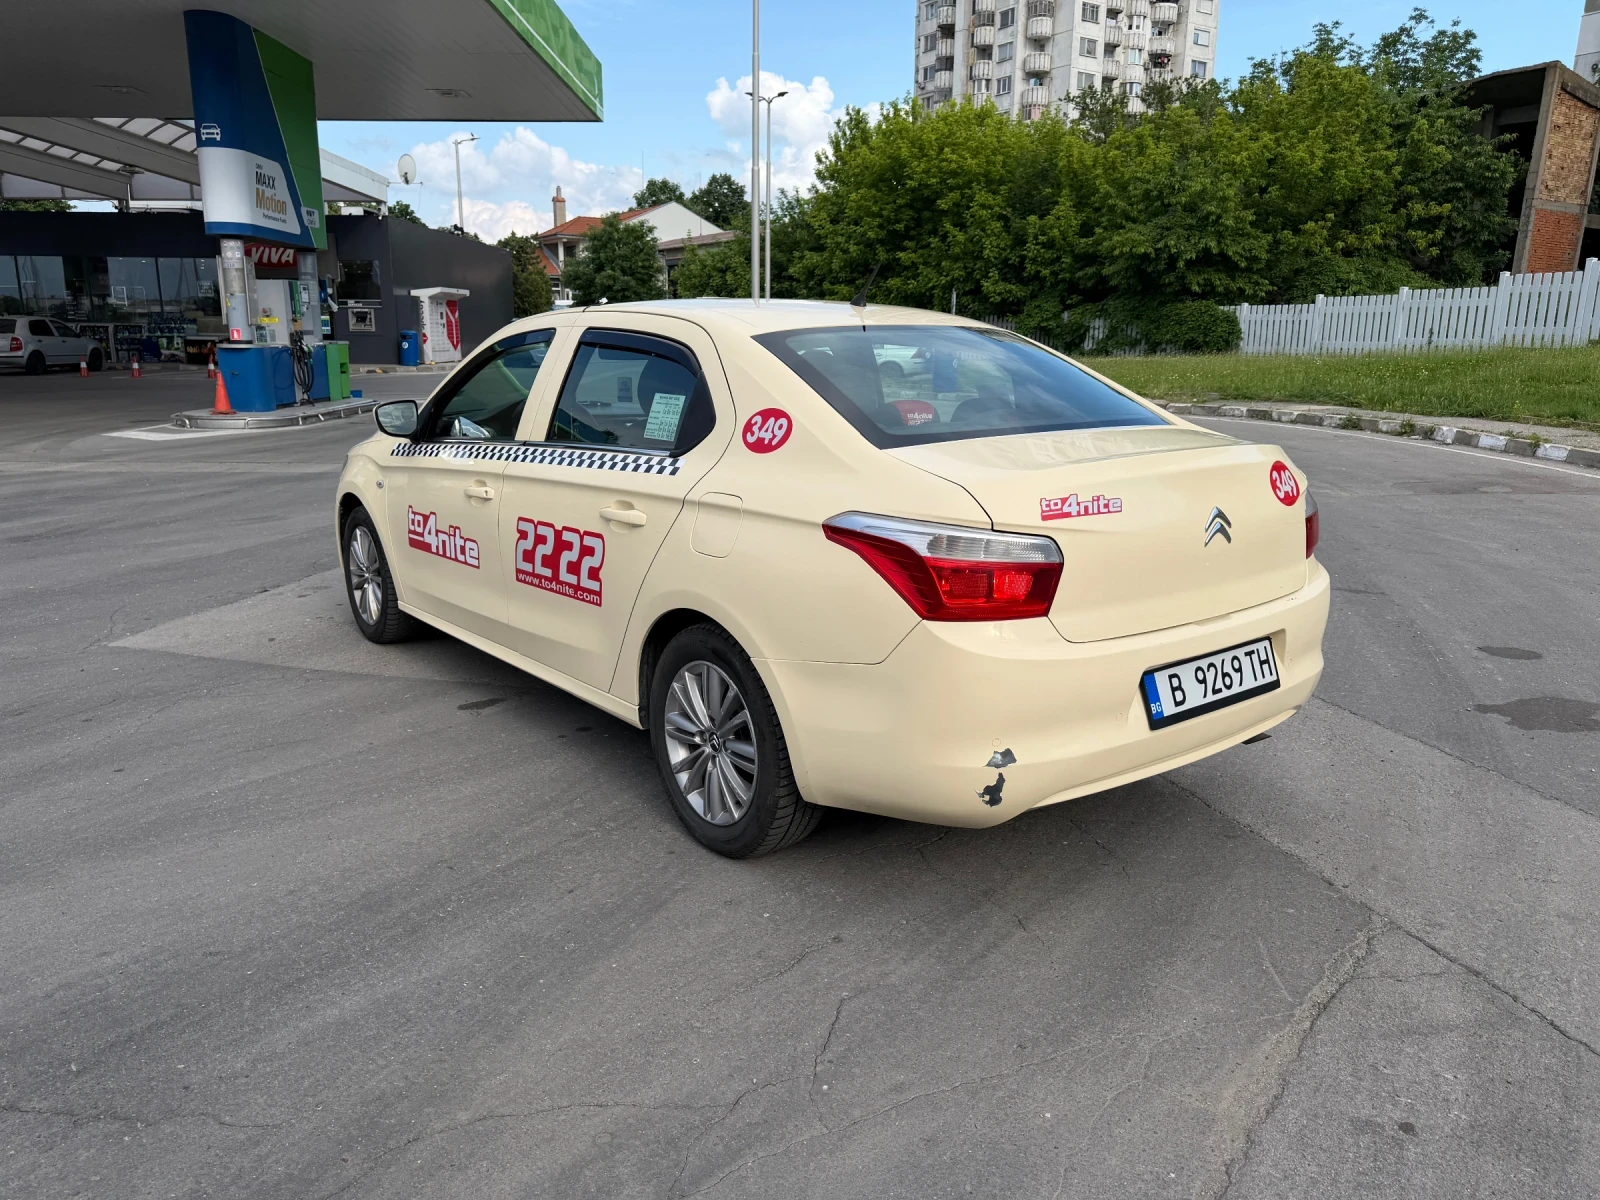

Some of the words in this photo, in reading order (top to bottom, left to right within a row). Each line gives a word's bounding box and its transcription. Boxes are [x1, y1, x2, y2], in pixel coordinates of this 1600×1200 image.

[255, 171, 276, 190] MAXX
[256, 188, 287, 216] Motion
[251, 247, 295, 264] VIVA
[746, 415, 788, 446] 349
[1272, 469, 1297, 499] 349
[1040, 494, 1122, 517] to4nite
[408, 506, 479, 567] to4nite
[517, 572, 600, 604] www.to4nite.com
[1168, 673, 1186, 707] B
[1194, 655, 1243, 699] 9269
[1244, 645, 1273, 682] TH
[1151, 703, 1162, 714] BG
